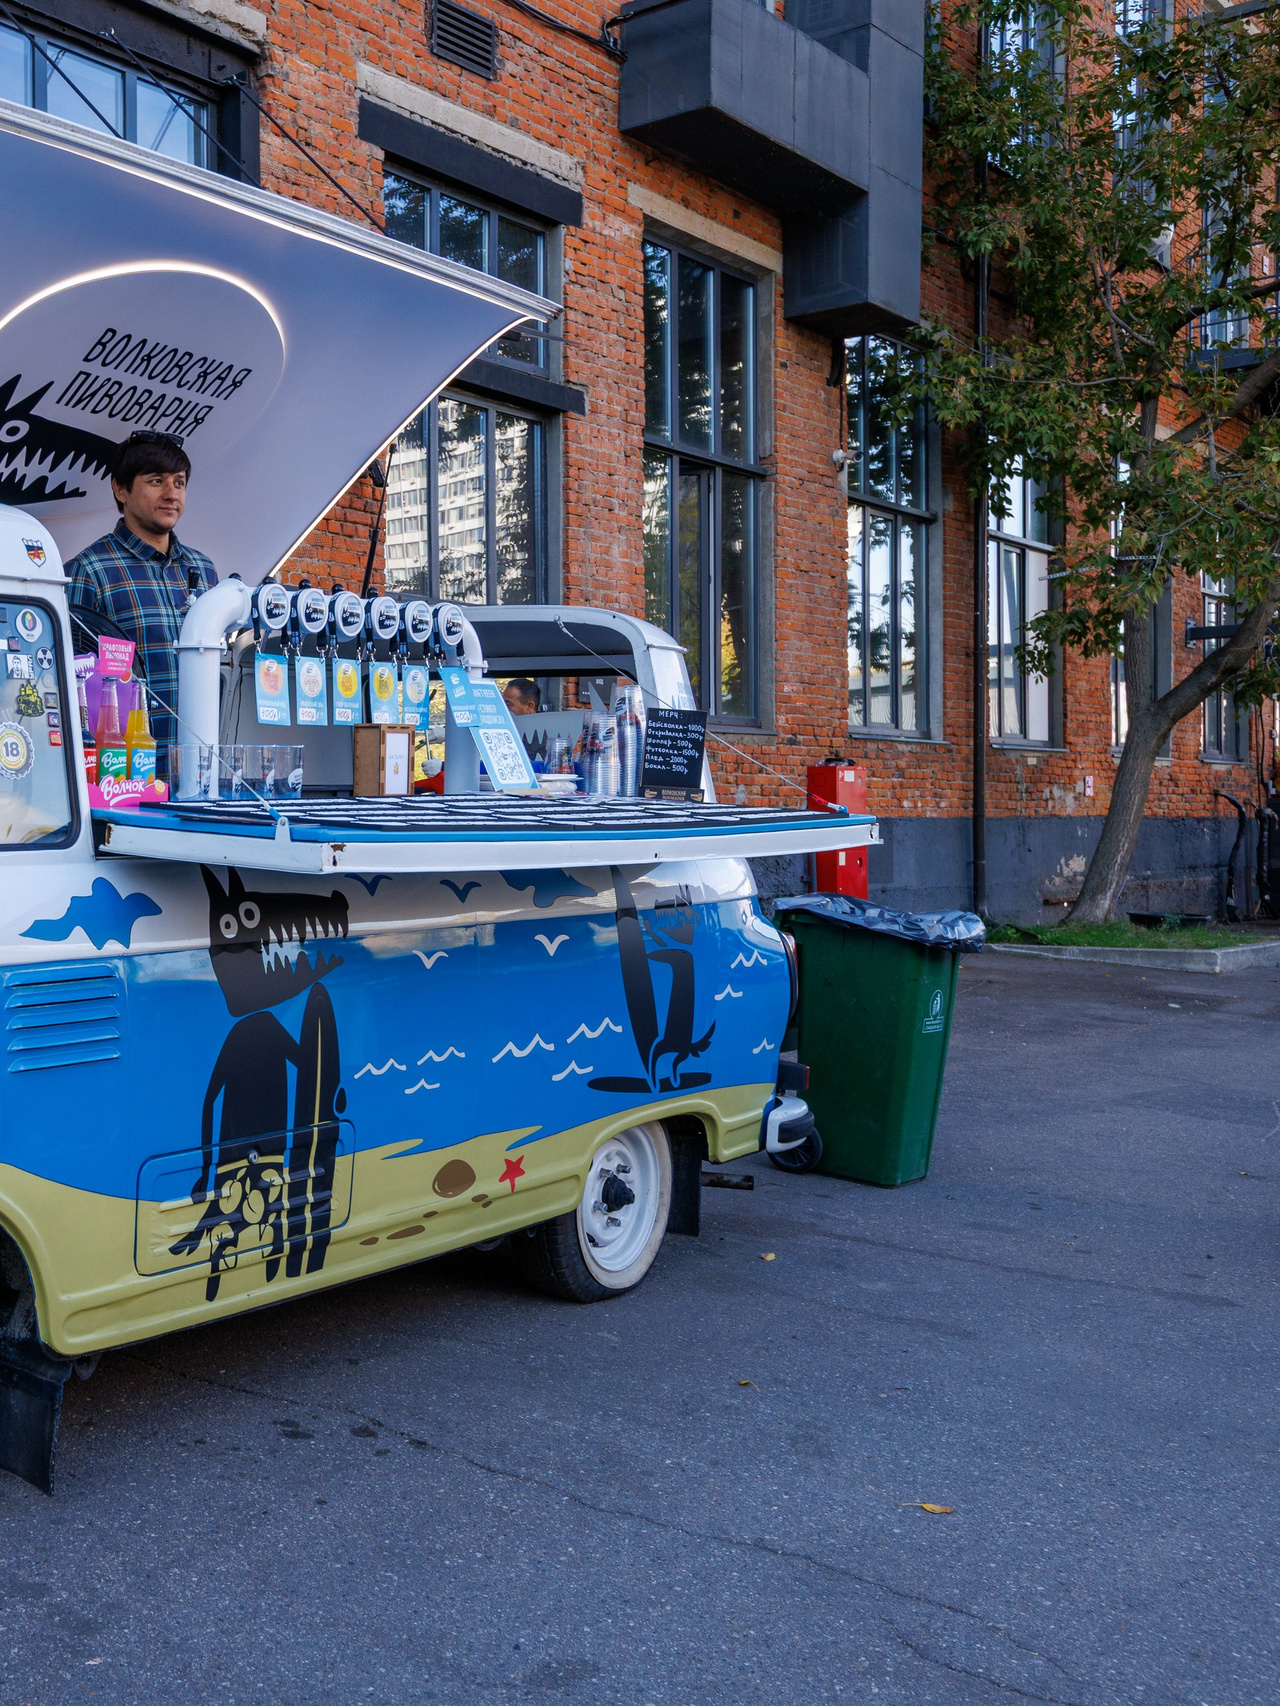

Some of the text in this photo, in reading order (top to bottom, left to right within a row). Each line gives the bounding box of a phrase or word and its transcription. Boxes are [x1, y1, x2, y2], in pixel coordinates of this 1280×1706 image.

[82, 327, 253, 401] ВОЛКОВСКАЯ
[56, 370, 214, 437] ПИВОВАРНЯ
[3, 741, 20, 758] 18
[101, 775, 145, 800] Волчок
